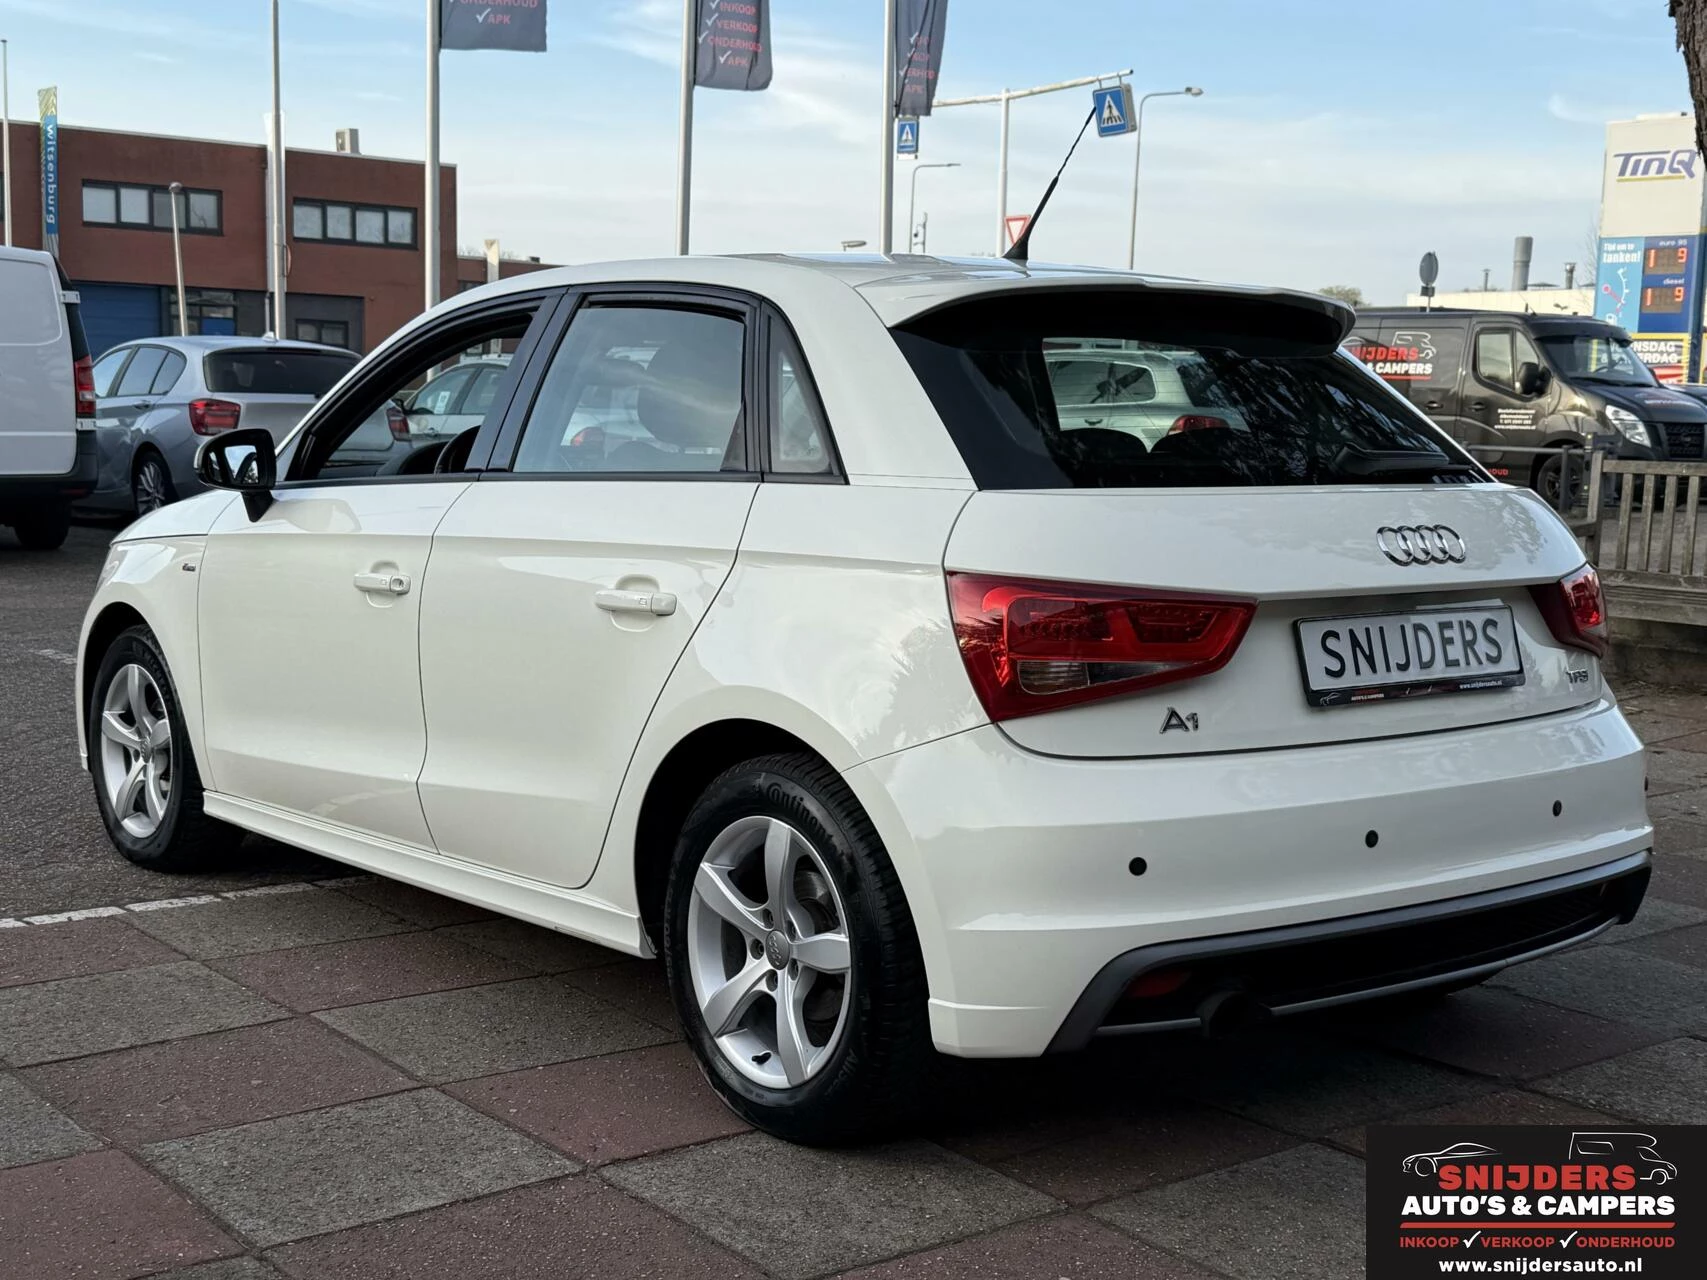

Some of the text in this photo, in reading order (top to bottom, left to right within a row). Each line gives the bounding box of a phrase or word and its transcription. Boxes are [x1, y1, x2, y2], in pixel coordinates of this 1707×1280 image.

[487, 14, 512, 25] APK
[46, 124, 56, 224] witsenburg
[1348, 347, 1419, 361] NIJDERS
[1376, 362, 1433, 375] CAMPERS
[1320, 618, 1503, 678] SNIJDERS
[1160, 706, 1199, 734] A1
